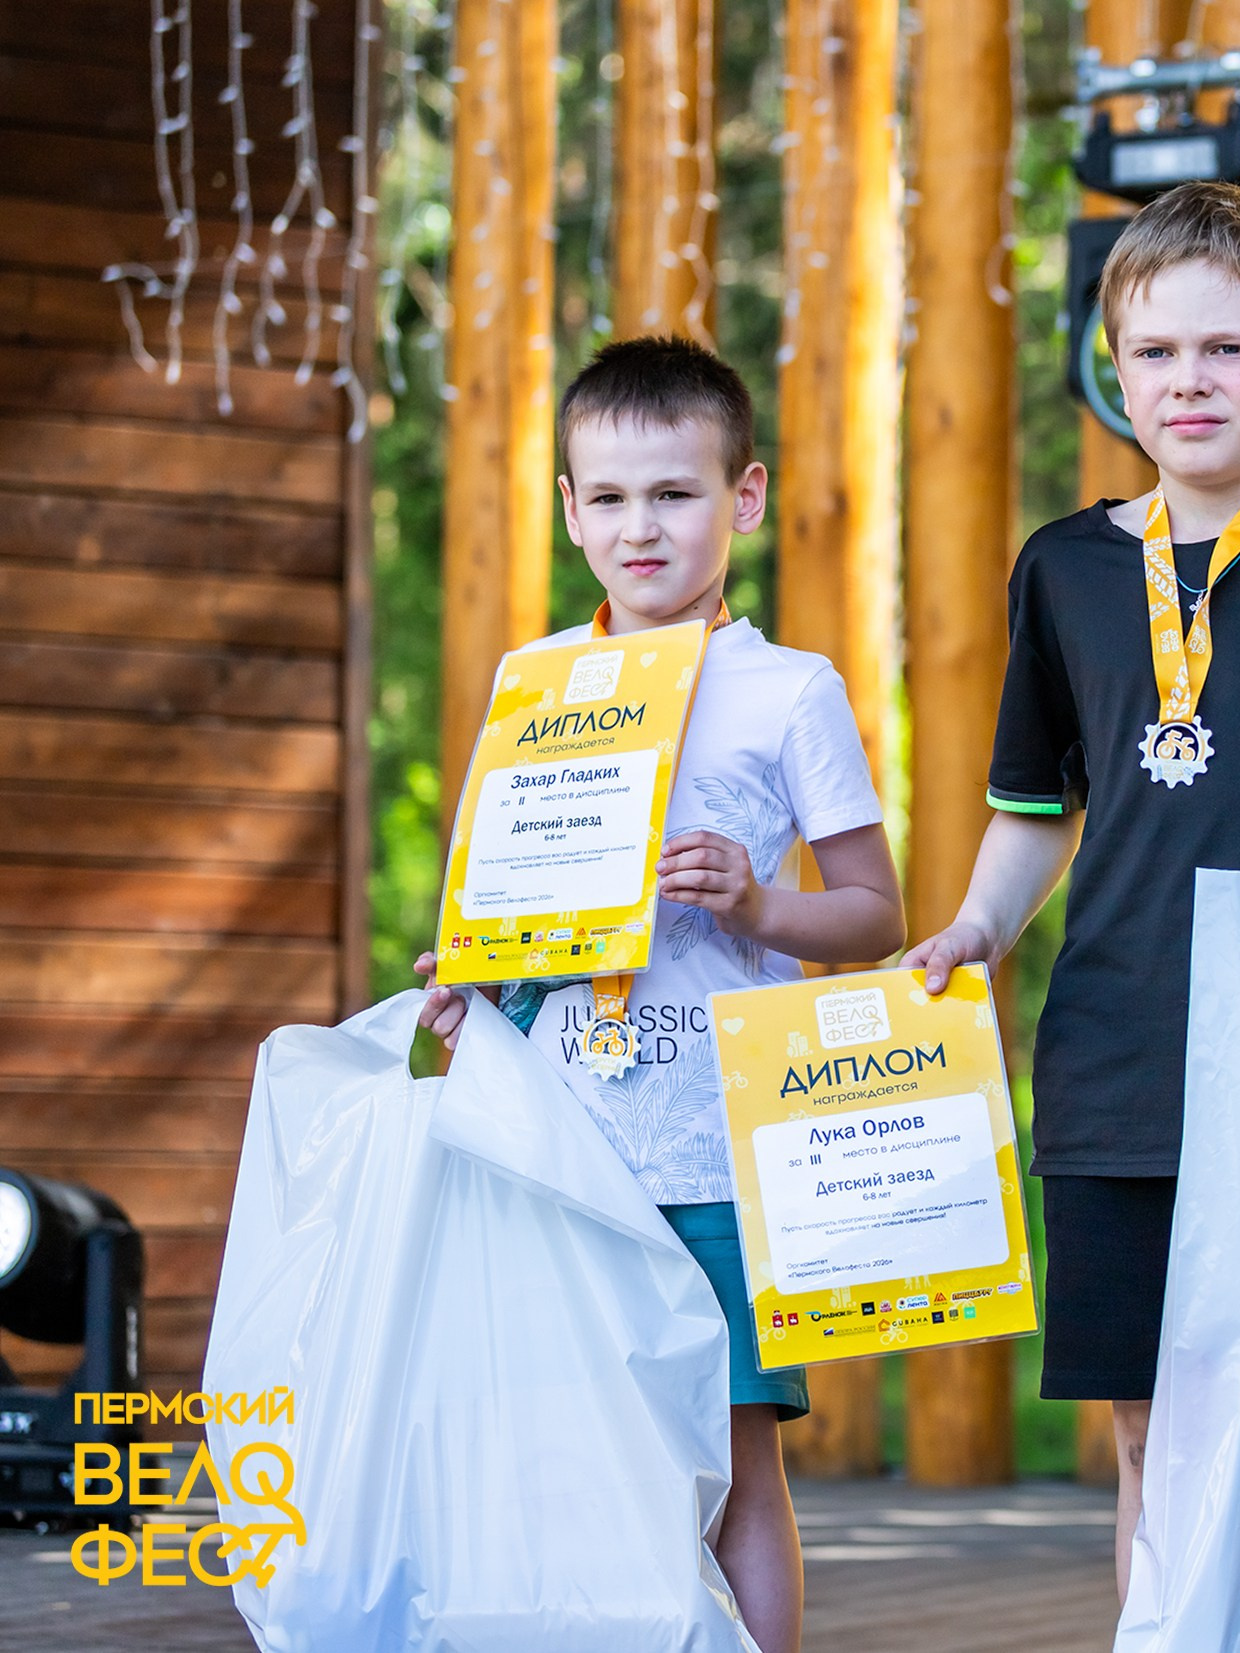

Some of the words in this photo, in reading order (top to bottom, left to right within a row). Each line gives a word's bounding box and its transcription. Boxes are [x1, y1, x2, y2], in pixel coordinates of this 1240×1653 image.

[517, 702, 647, 747] ДИПЛОМ
[536, 737, 615, 754] награждается
[510, 773, 556, 789] Захар
[560, 767, 620, 784] Гладких
[540, 792, 566, 802] место
[575, 786, 630, 799] дисциплине
[511, 816, 563, 834] Детский
[566, 815, 602, 828] заезд
[544, 834, 555, 842] 6-8
[561, 1005, 708, 1032] JUSSIC
[823, 1004, 883, 1026] ВЕЛО
[561, 1037, 677, 1064] WLD
[780, 1042, 946, 1098] ДИПЛОМ
[813, 1082, 918, 1106] награждается
[809, 1125, 856, 1146] Лука
[862, 1116, 925, 1137] Орлов
[788, 1158, 802, 1168] за
[842, 1146, 878, 1160] место
[880, 1145, 888, 1153] в
[890, 1134, 961, 1152] дисциплине
[816, 1172, 883, 1197] Детский
[887, 1168, 935, 1184] заезд
[862, 1192, 876, 1200] 6-8
[878, 1190, 892, 1199] лет
